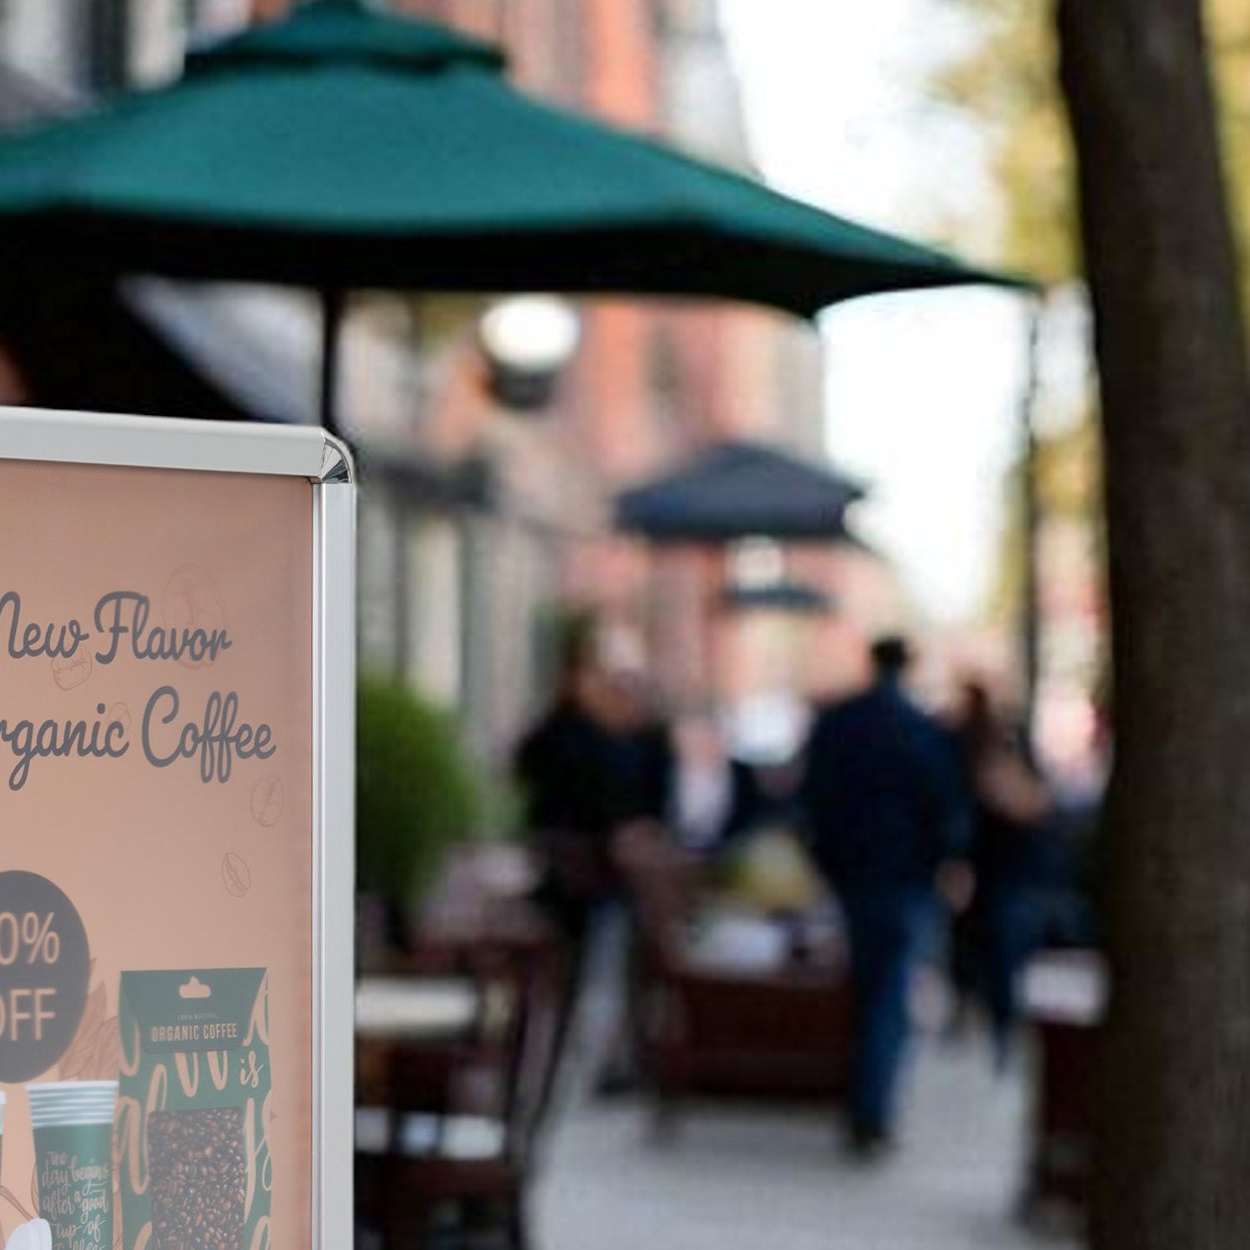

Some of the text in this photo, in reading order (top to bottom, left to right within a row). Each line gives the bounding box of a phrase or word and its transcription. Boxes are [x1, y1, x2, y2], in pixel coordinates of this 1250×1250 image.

[94, 591, 232, 664] Flavor
[142, 686, 276, 784] Coffee
[151, 1022, 238, 1042] ORGANIC COFFEE
